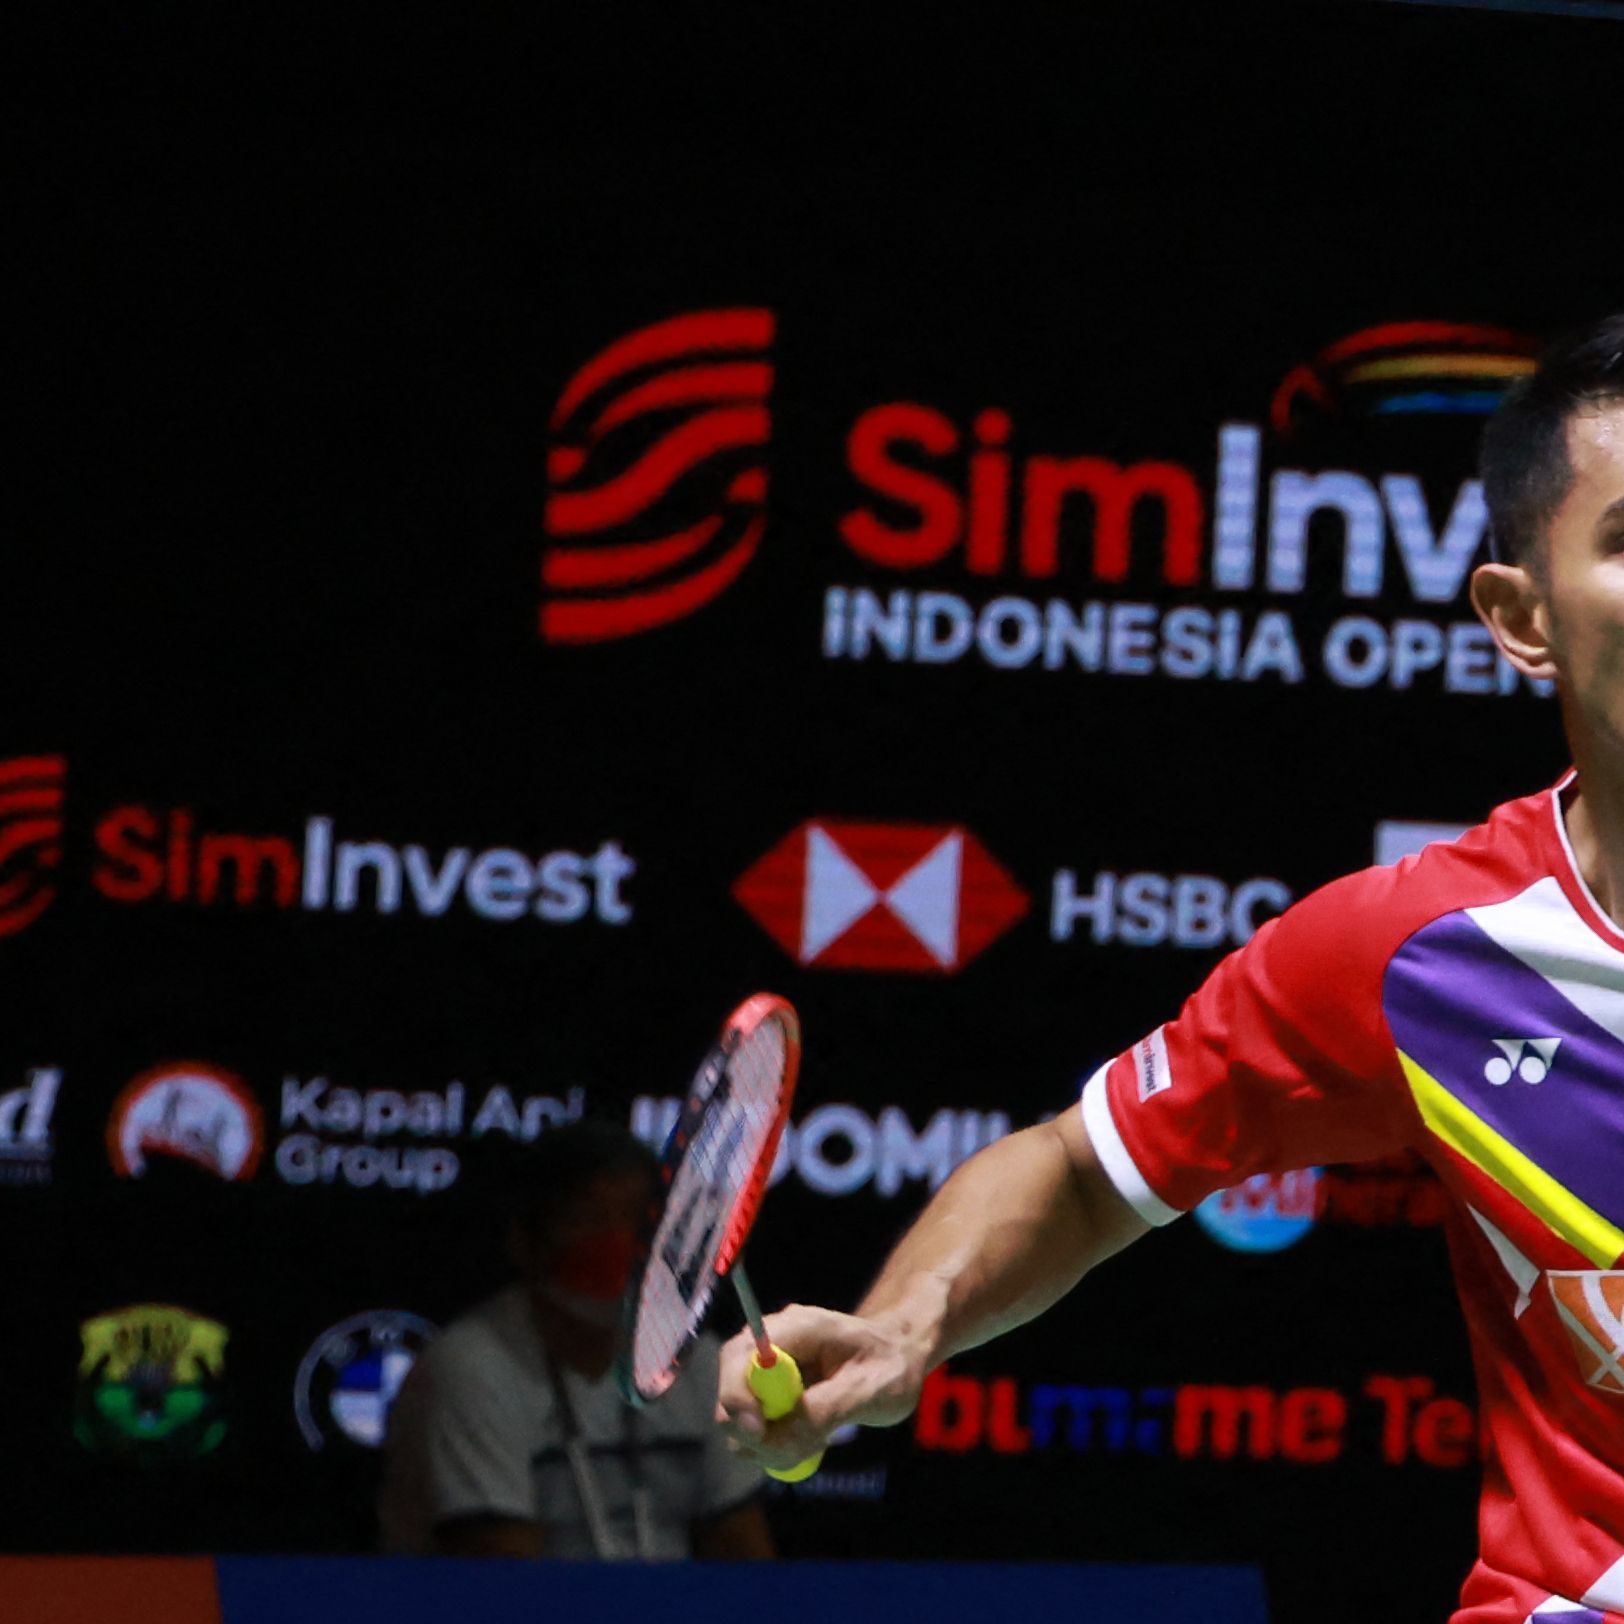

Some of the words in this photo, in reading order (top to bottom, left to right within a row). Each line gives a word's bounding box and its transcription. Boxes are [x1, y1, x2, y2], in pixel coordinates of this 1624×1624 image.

[838, 401, 1490, 596] SimInv
[822, 586, 1304, 683] INDONESIA
[92, 806, 637, 925] SimInvest
[1051, 868, 1292, 949] HSBC
[281, 1077, 465, 1139] Kapal
[274, 1134, 461, 1193] Group
